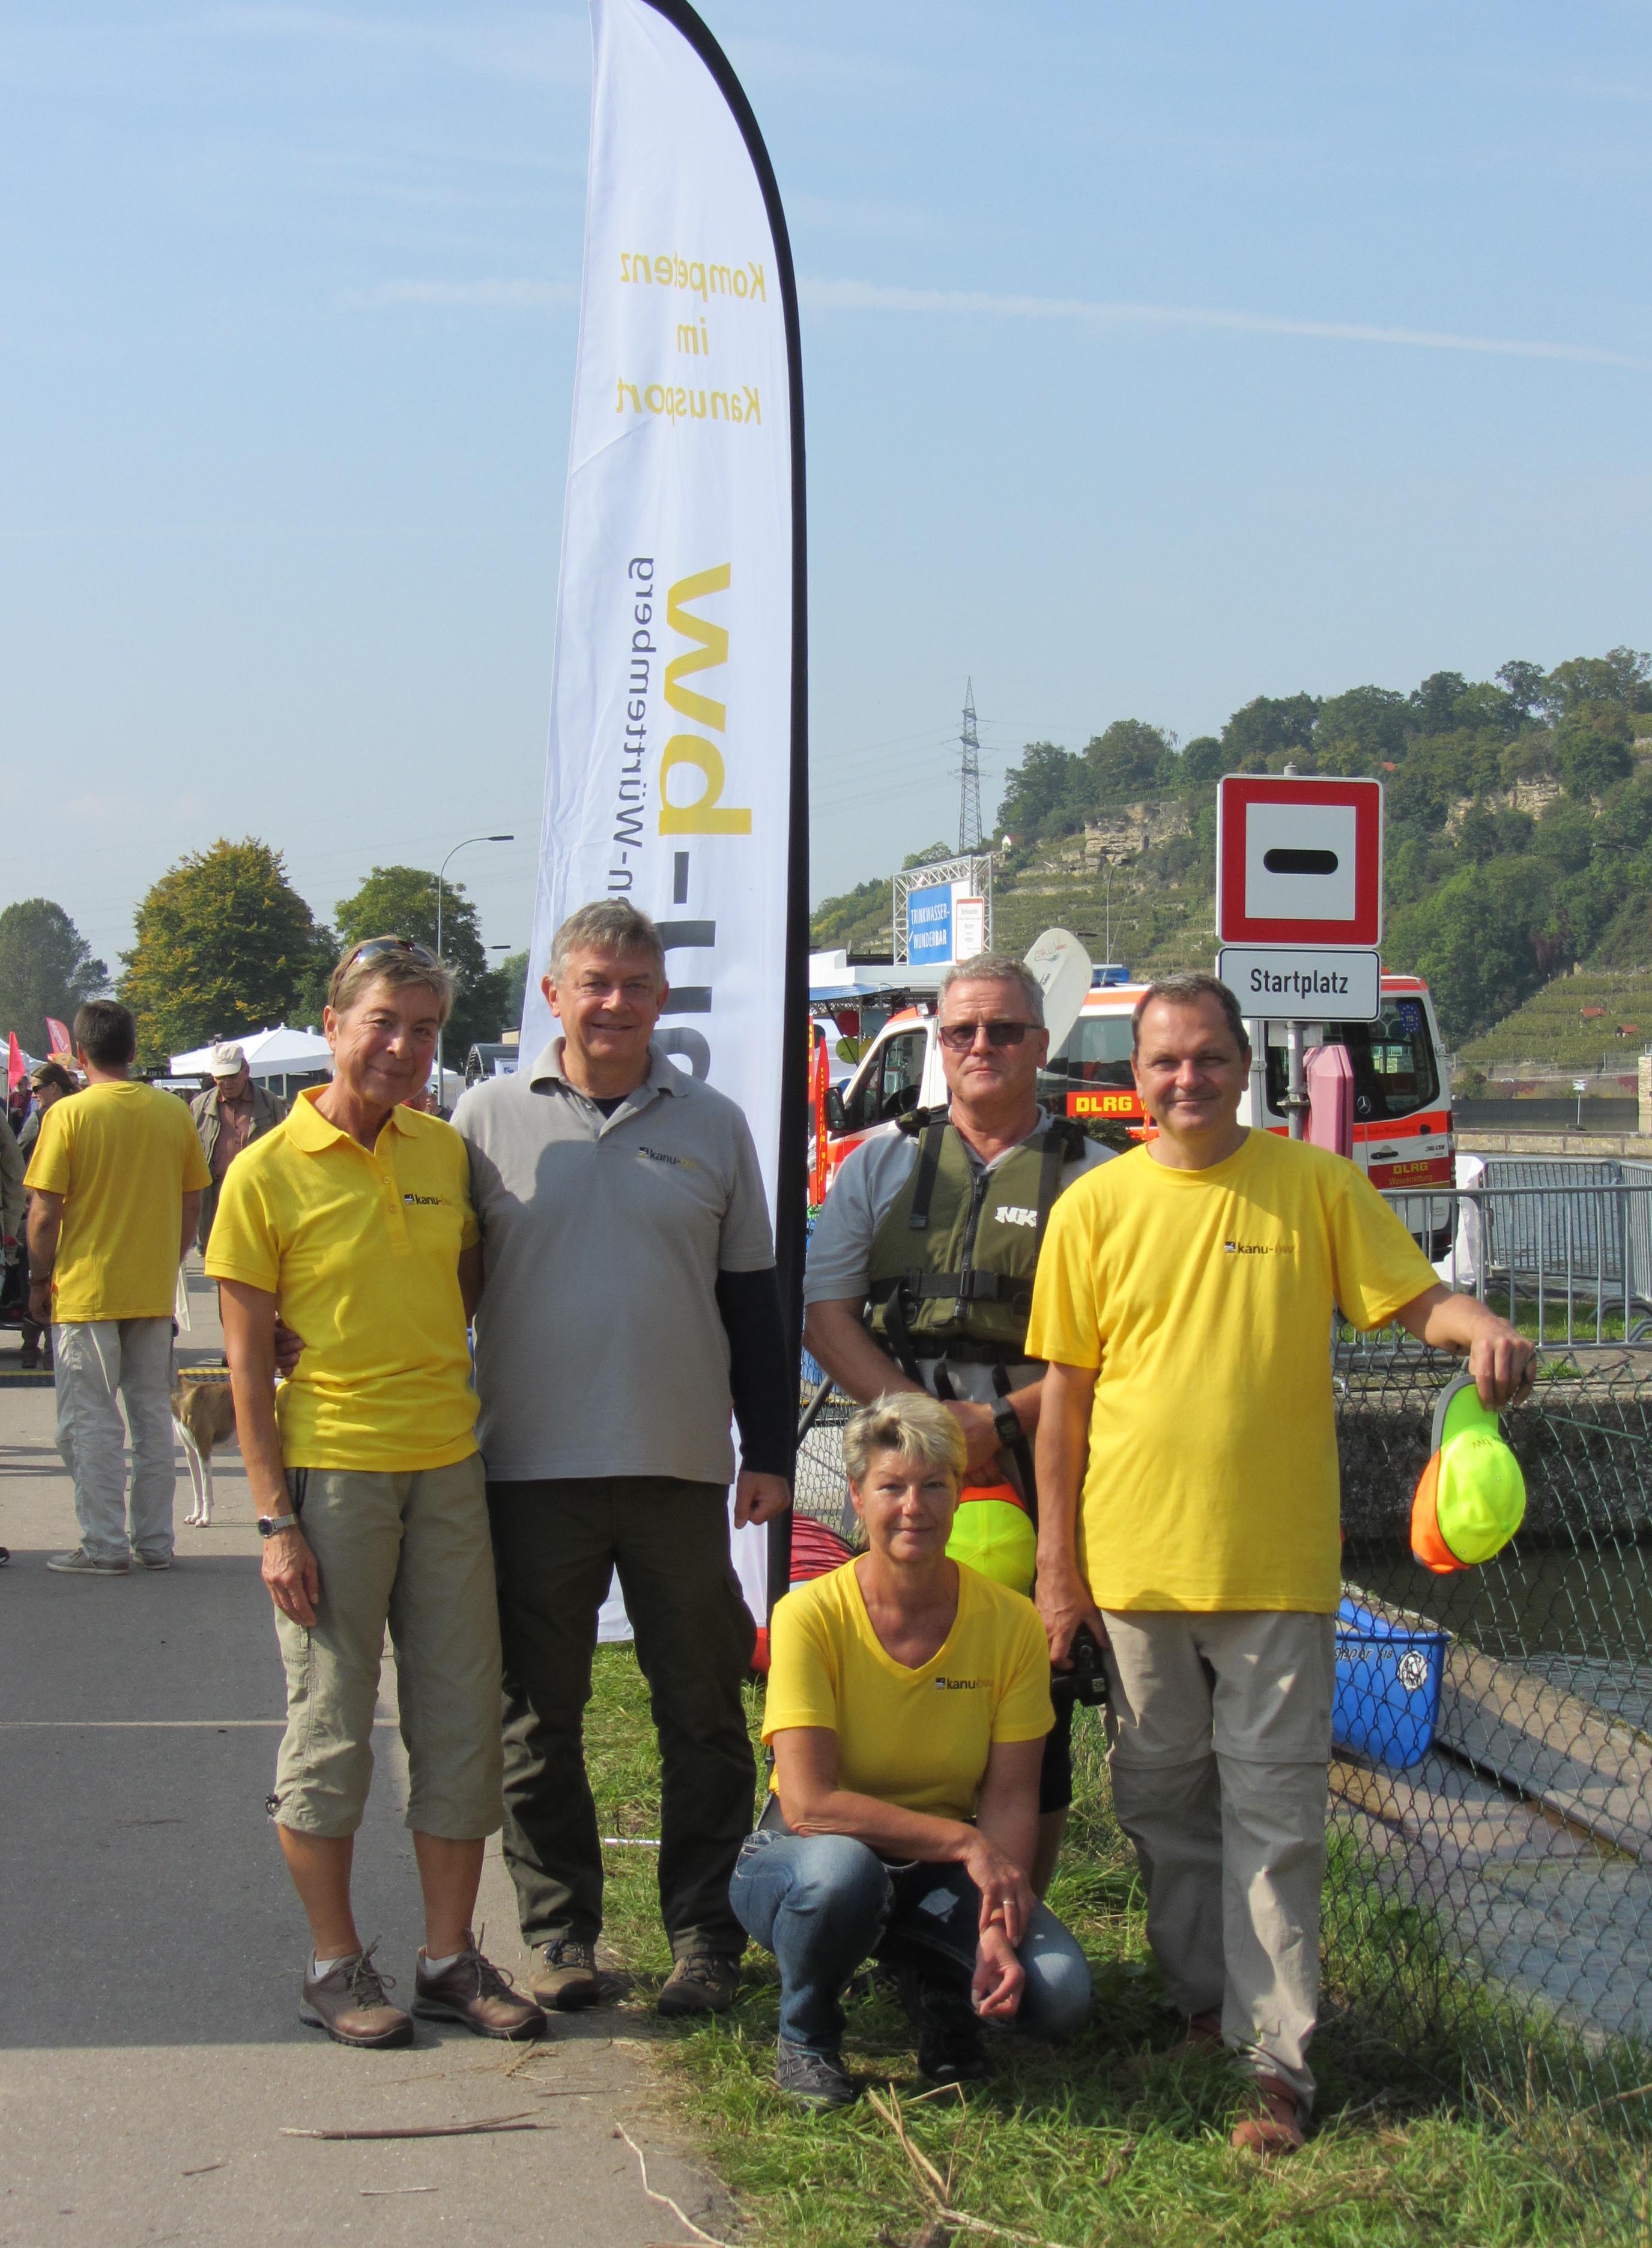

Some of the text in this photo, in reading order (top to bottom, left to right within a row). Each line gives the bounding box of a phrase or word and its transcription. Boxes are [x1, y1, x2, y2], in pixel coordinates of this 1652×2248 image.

[910, 902, 950, 925] TRINKWASSER-
[913, 928, 947, 949] WUNDERBAR
[1250, 968, 1349, 1000] Startplatz
[1076, 1096, 1133, 1112] DLRG
[1393, 1162, 1429, 1175] DLRG
[1388, 1174, 1433, 1186] Wasserrettung
